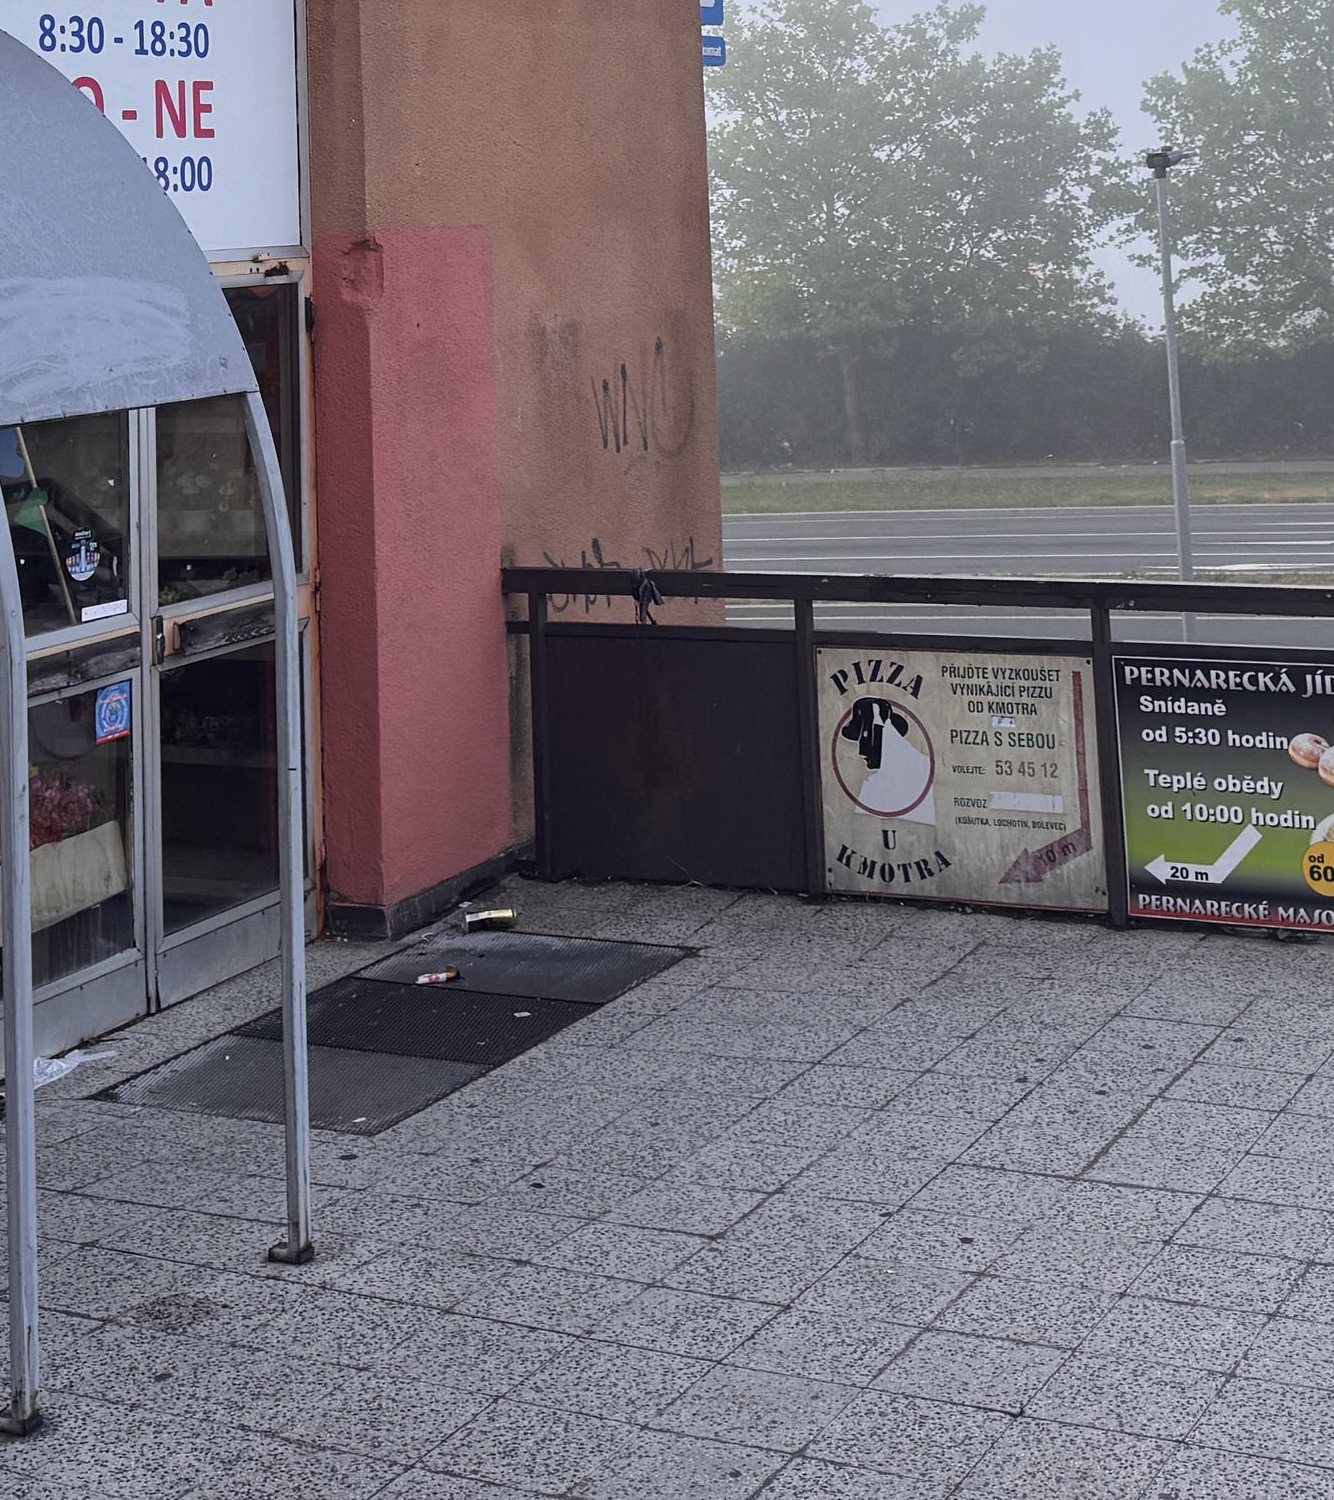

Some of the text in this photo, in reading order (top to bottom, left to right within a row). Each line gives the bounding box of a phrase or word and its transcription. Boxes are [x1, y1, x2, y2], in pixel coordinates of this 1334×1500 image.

[38, 14, 105, 54] 8:30
[134, 20, 210, 59] 18:30
[155, 80, 215, 139] NE
[830, 659, 924, 699] PIZZA
[992, 665, 1061, 682] VYZKOUŠET
[1124, 665, 1297, 694] PERNARECKÁ
[1019, 686, 1053, 699] PIZZU
[968, 701, 1037, 715] OD KMOTRA
[1139, 695, 1227, 717] Snídaně
[950, 729, 1056, 750] PIZZA S SEBOU
[1142, 726, 1289, 750] od 5:30 hodin
[995, 760, 1013, 776] 53
[1018, 761, 1035, 777] 45
[1041, 762, 1058, 779] 12
[1144, 768, 1283, 799] Teplé obědy
[954, 797, 988, 809] ROZVOZ
[1147, 802, 1316, 830] od 10:00 hodin
[881, 830, 897, 850] U
[1062, 842, 1077, 857] m
[836, 844, 952, 883] KMOTRA
[1308, 853, 1325, 864] od
[1170, 866, 1209, 881] 20 m
[1138, 893, 1269, 920] PERNARECKÉ
